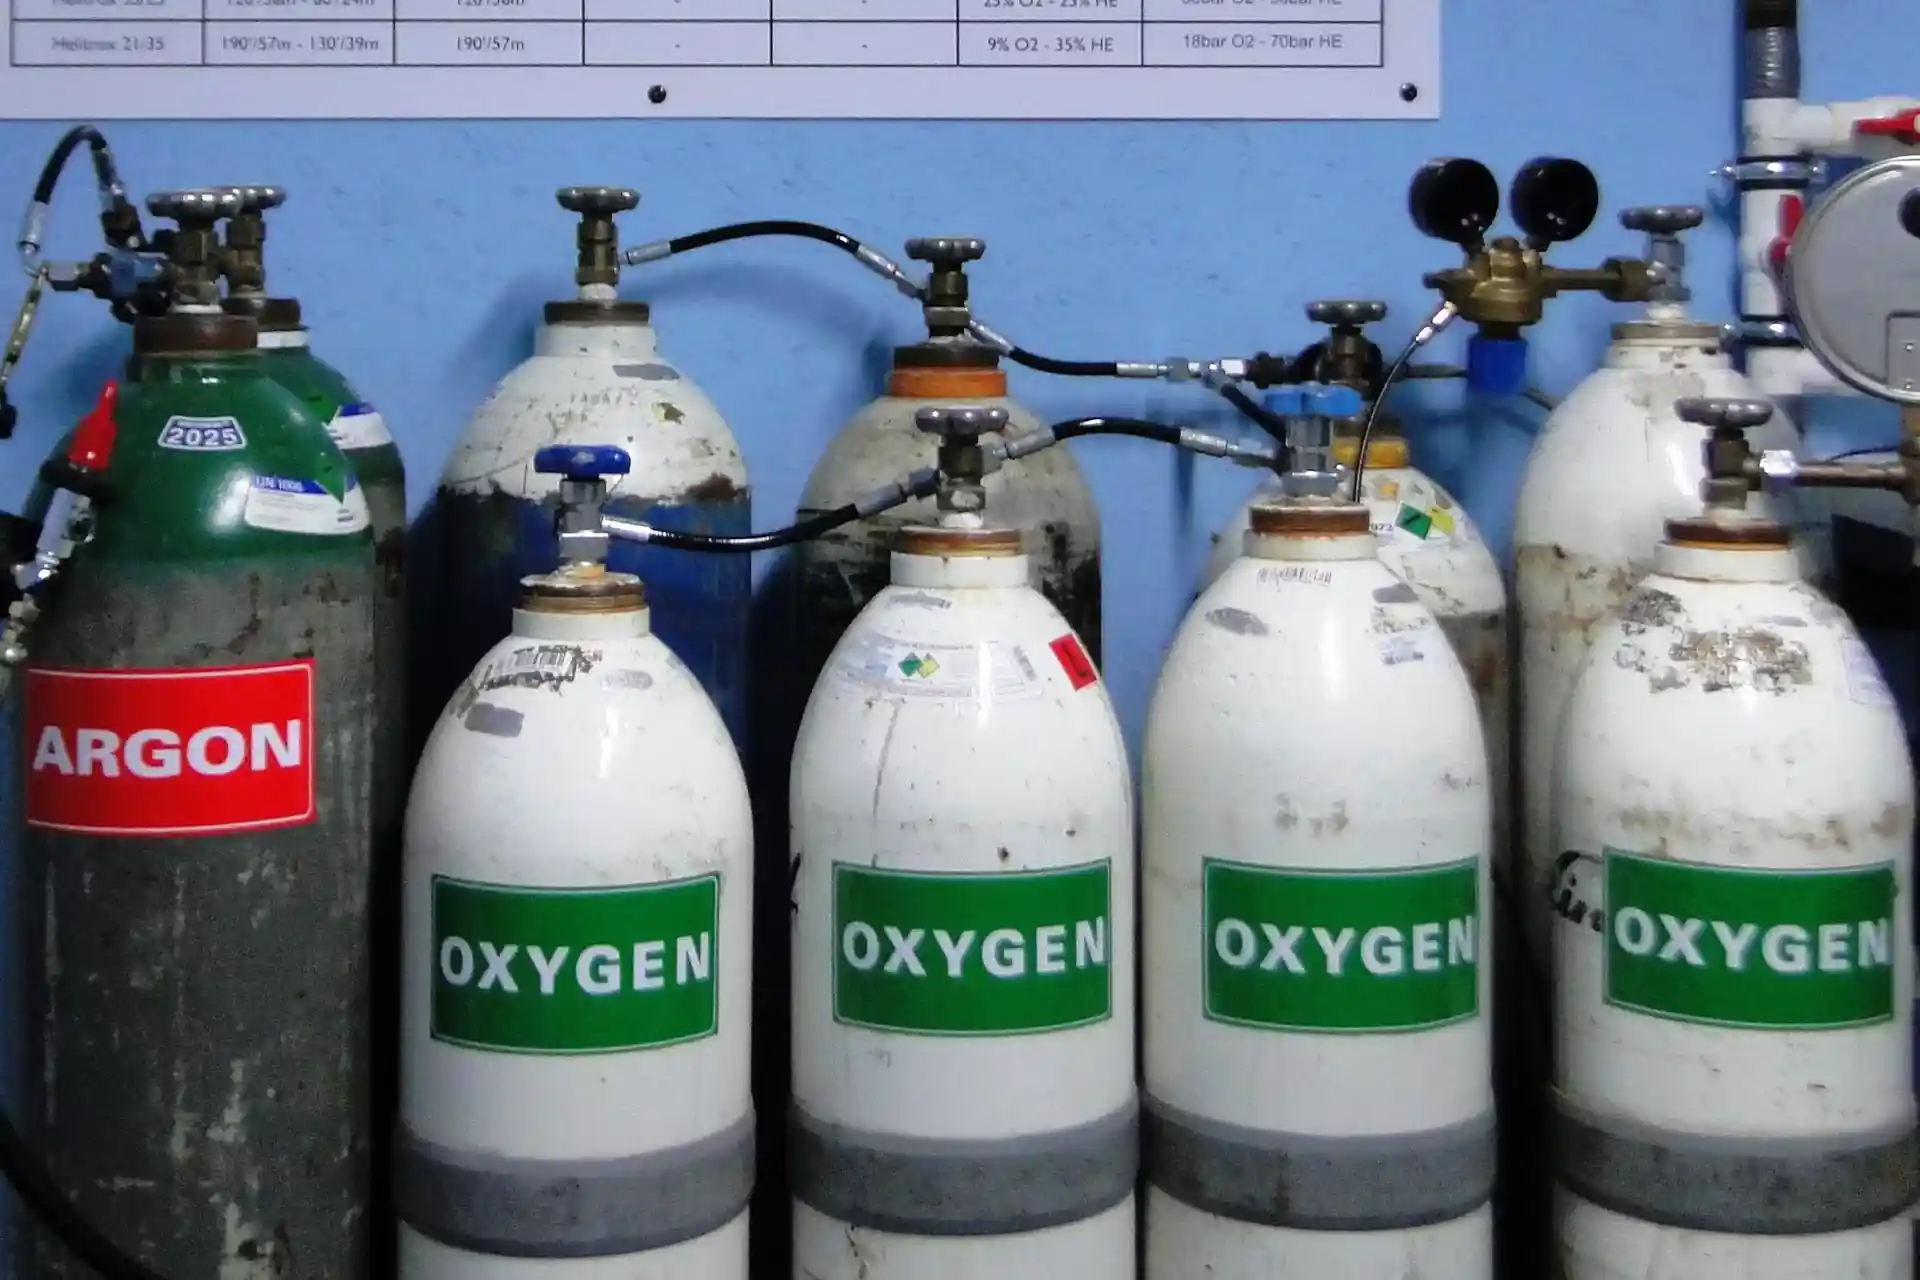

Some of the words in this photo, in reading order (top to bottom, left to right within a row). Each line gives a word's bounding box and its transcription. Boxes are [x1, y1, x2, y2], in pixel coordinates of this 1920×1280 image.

[987, 37, 1010, 52] 9%
[1054, 37, 1086, 52] 35%
[1091, 37, 1114, 52] HE
[1183, 33, 1227, 48] 18bar
[1231, 33, 1254, 48] O2
[1270, 34, 1314, 48] 70bar
[1319, 34, 1343, 48] HE
[166, 427, 237, 446] 2025
[32, 718, 303, 779] ARGON
[439, 931, 711, 995] OXYGEN
[842, 916, 1107, 978] OXYGEN
[1215, 916, 1476, 975] OXYGEN
[1614, 907, 1890, 973] OXYGEN
